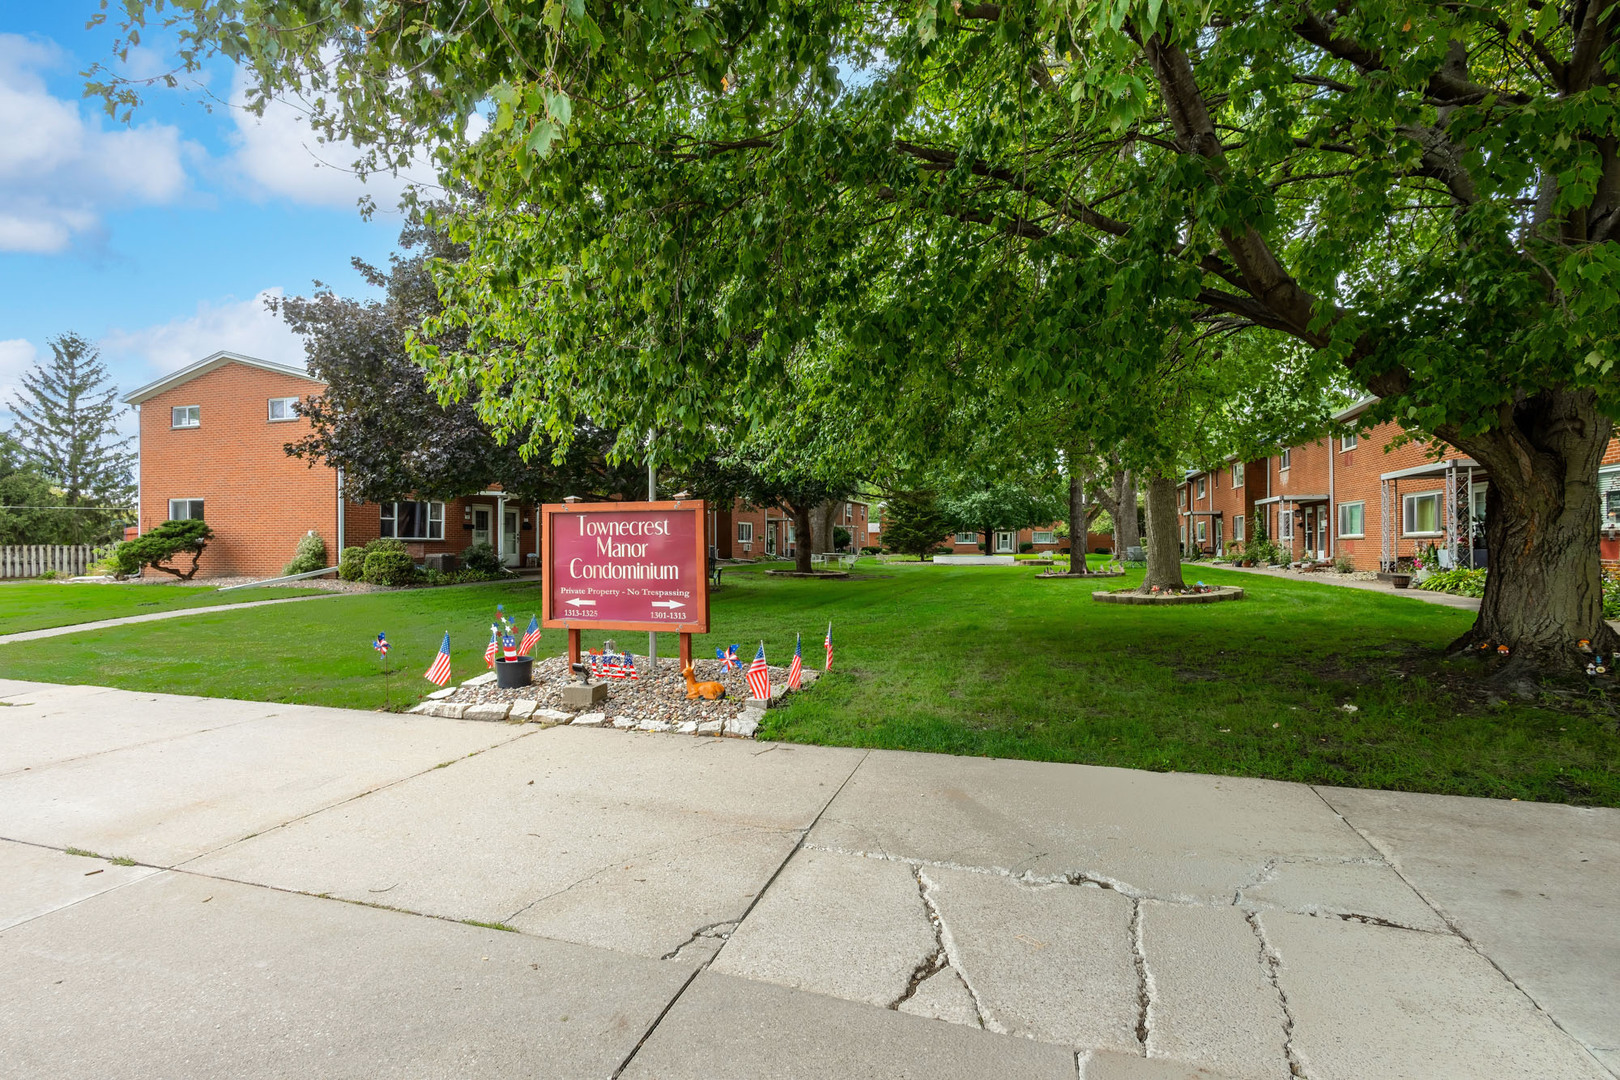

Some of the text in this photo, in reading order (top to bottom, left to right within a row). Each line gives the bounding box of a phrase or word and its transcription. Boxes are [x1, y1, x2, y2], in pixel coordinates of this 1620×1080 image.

[577, 515, 670, 536] Townecrest
[597, 536, 648, 558] Manor
[570, 558, 678, 580] Condominium
[560, 587, 585, 595] Private
[587, 588, 620, 597] Property
[641, 589, 690, 598] Trespassing
[651, 612, 687, 620] 1301-1313
